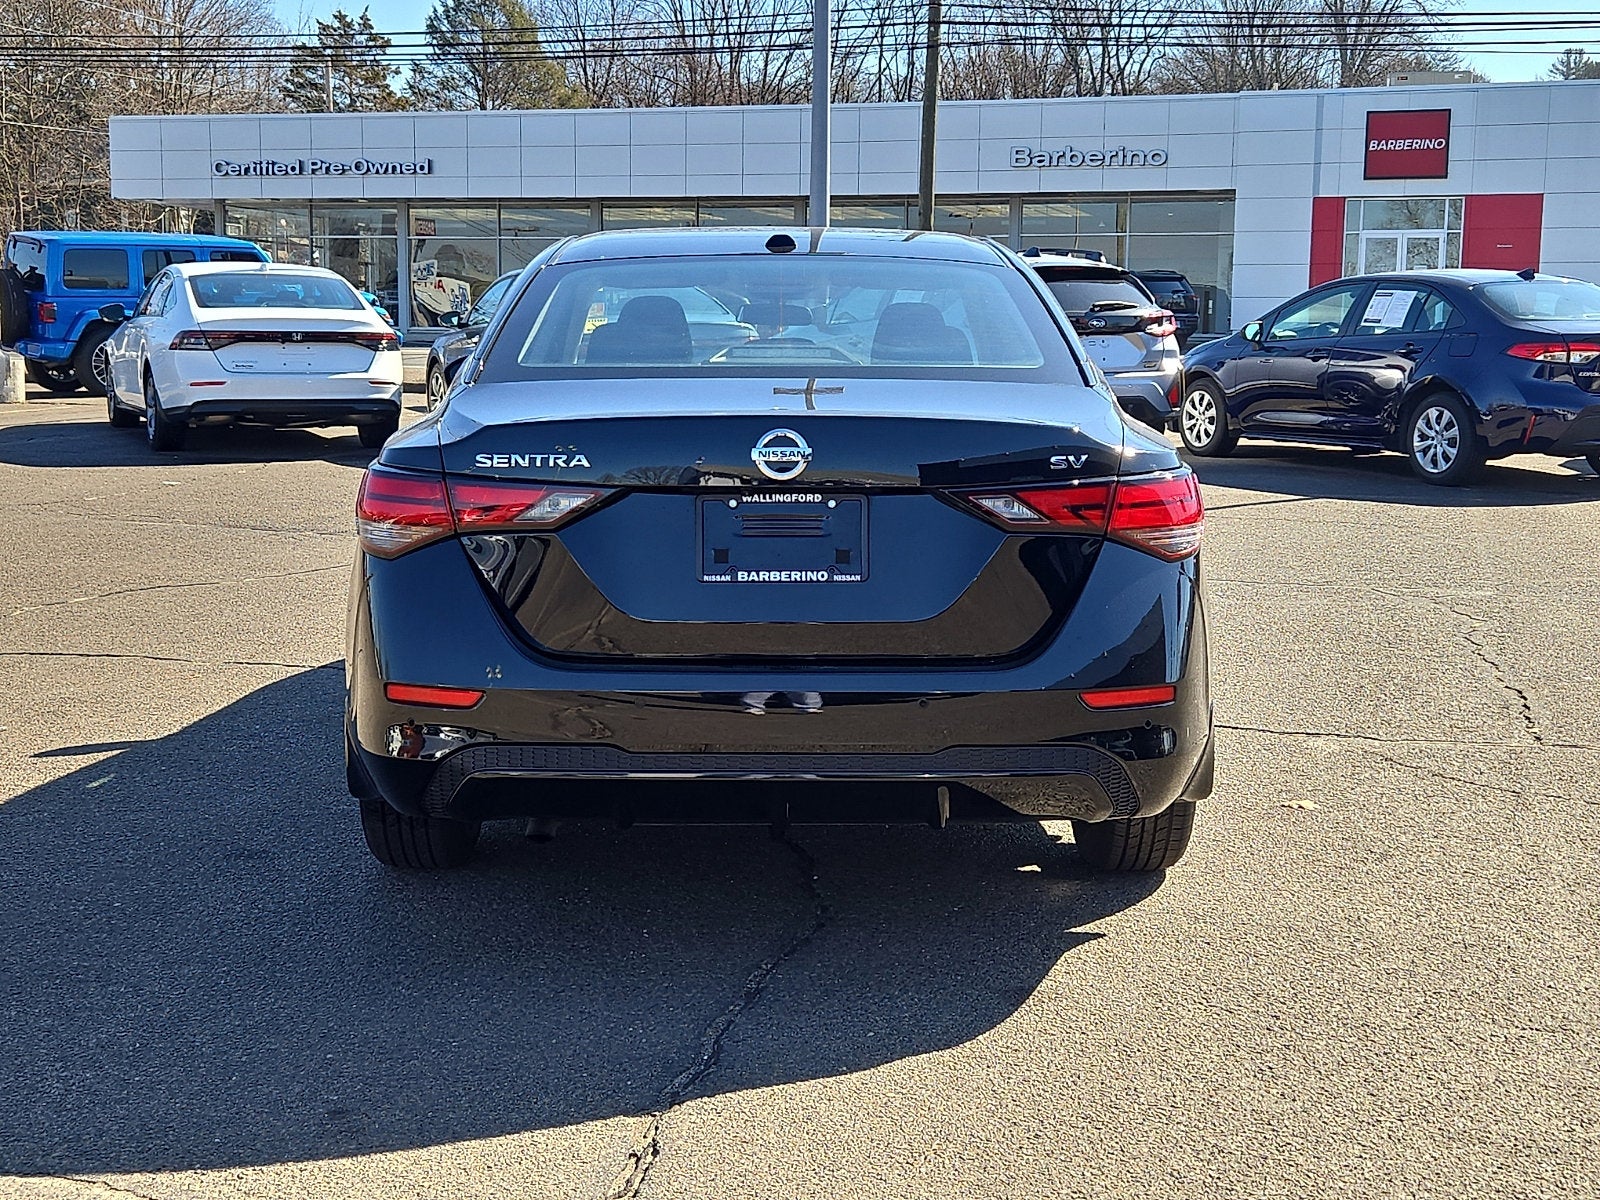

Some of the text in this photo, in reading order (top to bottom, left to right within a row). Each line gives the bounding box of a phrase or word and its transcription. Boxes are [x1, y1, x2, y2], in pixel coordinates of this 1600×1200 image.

[1369, 138, 1446, 151] BARBERINO
[1010, 145, 1168, 168] Barberino
[212, 157, 433, 176] Certified Pre-Owned
[475, 453, 591, 468] SENTRA
[758, 450, 806, 458] NISSAN
[1050, 454, 1088, 469] SV
[742, 493, 822, 503] WALLINGFORD
[703, 570, 861, 582] NISSAN BARBERINO NISSAN
